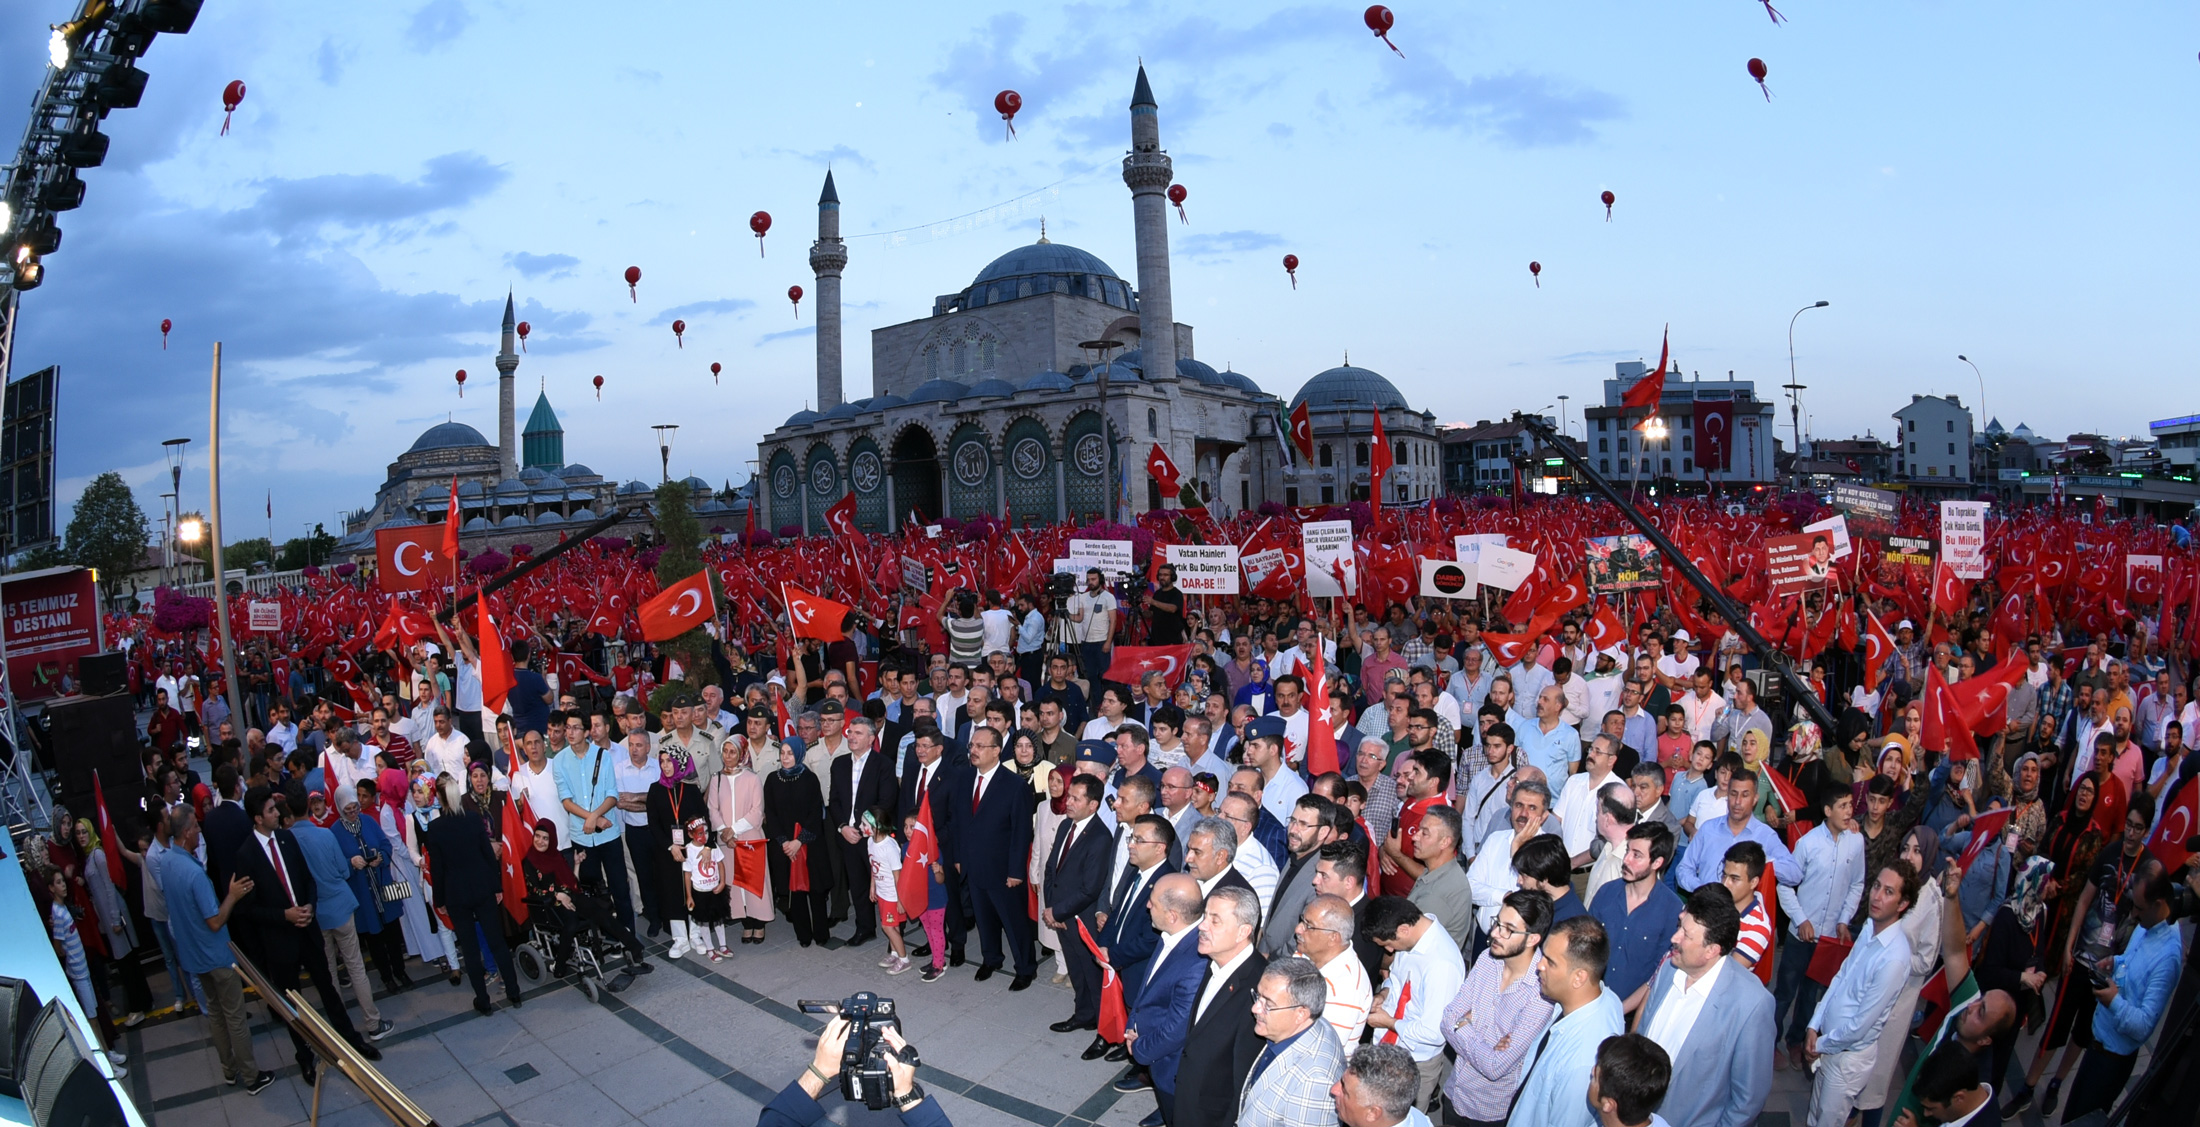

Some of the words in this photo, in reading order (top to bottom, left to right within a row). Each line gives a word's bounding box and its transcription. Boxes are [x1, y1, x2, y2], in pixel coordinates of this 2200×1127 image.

[1837, 487, 1847, 495] ÇAY
[1848, 488, 1858, 496] KOY
[1878, 502, 1893, 511] DERİN
[1948, 507, 1954, 516] Bu
[1955, 507, 1977, 518] Topraklar
[1944, 521, 1953, 533] Çok
[1955, 521, 1965, 531] Hain
[1889, 537, 1930, 550] GONYALIYIM
[1946, 535, 1955, 545] Bu
[1959, 535, 1981, 546] Millet
[1459, 543, 1469, 552] Sen
[1471, 543, 1480, 552] Dik
[1953, 548, 1973, 558] Hepsini
[1178, 549, 1198, 558] Vatan
[1199, 549, 1226, 558] Hainleri
[1189, 563, 1198, 572] Bu
[1200, 562, 1221, 574] Dünya
[1223, 563, 1237, 572] Size
[1497, 558, 1514, 568] Google
[1617, 569, 1639, 582] HÖH
[1217, 577, 1225, 589] !!!
[20, 593, 79, 615] TEMMUZ
[14, 611, 72, 634] DESTANI
